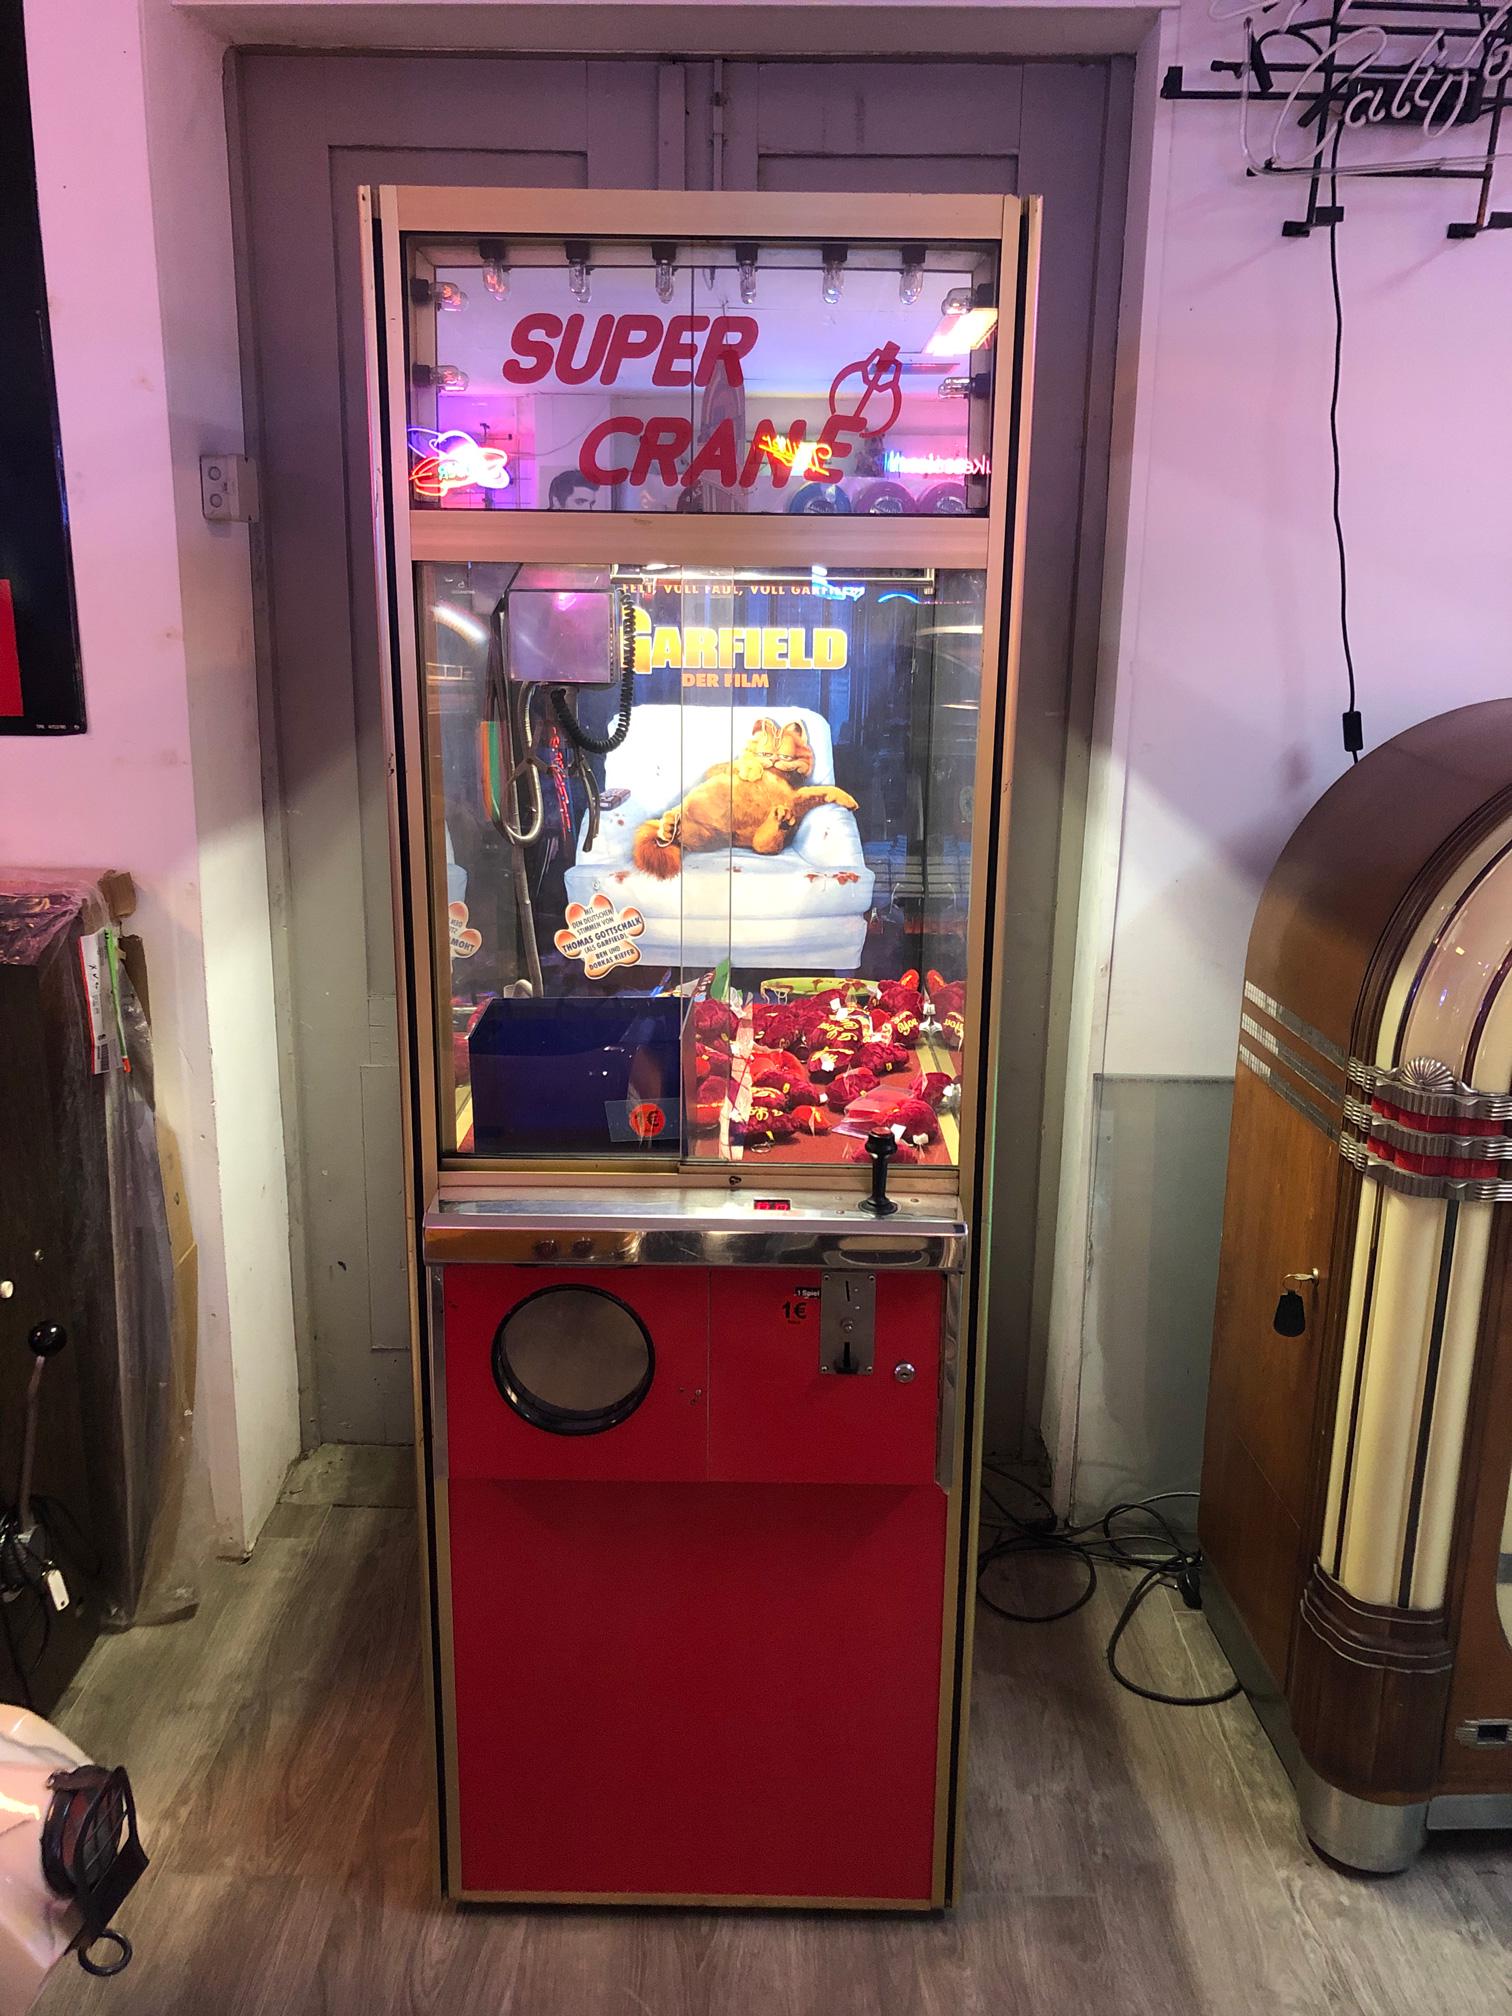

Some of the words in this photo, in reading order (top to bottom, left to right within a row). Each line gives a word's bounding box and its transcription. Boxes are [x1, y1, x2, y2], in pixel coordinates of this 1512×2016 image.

[502, 312, 759, 388] SUPER
[578, 415, 868, 489] CRANE
[681, 673, 719, 688] DER
[724, 674, 769, 688] FILM
[562, 935, 594, 953] THOMAS
[594, 917, 642, 940] GOTTSCHALK
[782, 1300, 807, 1319] 1€
